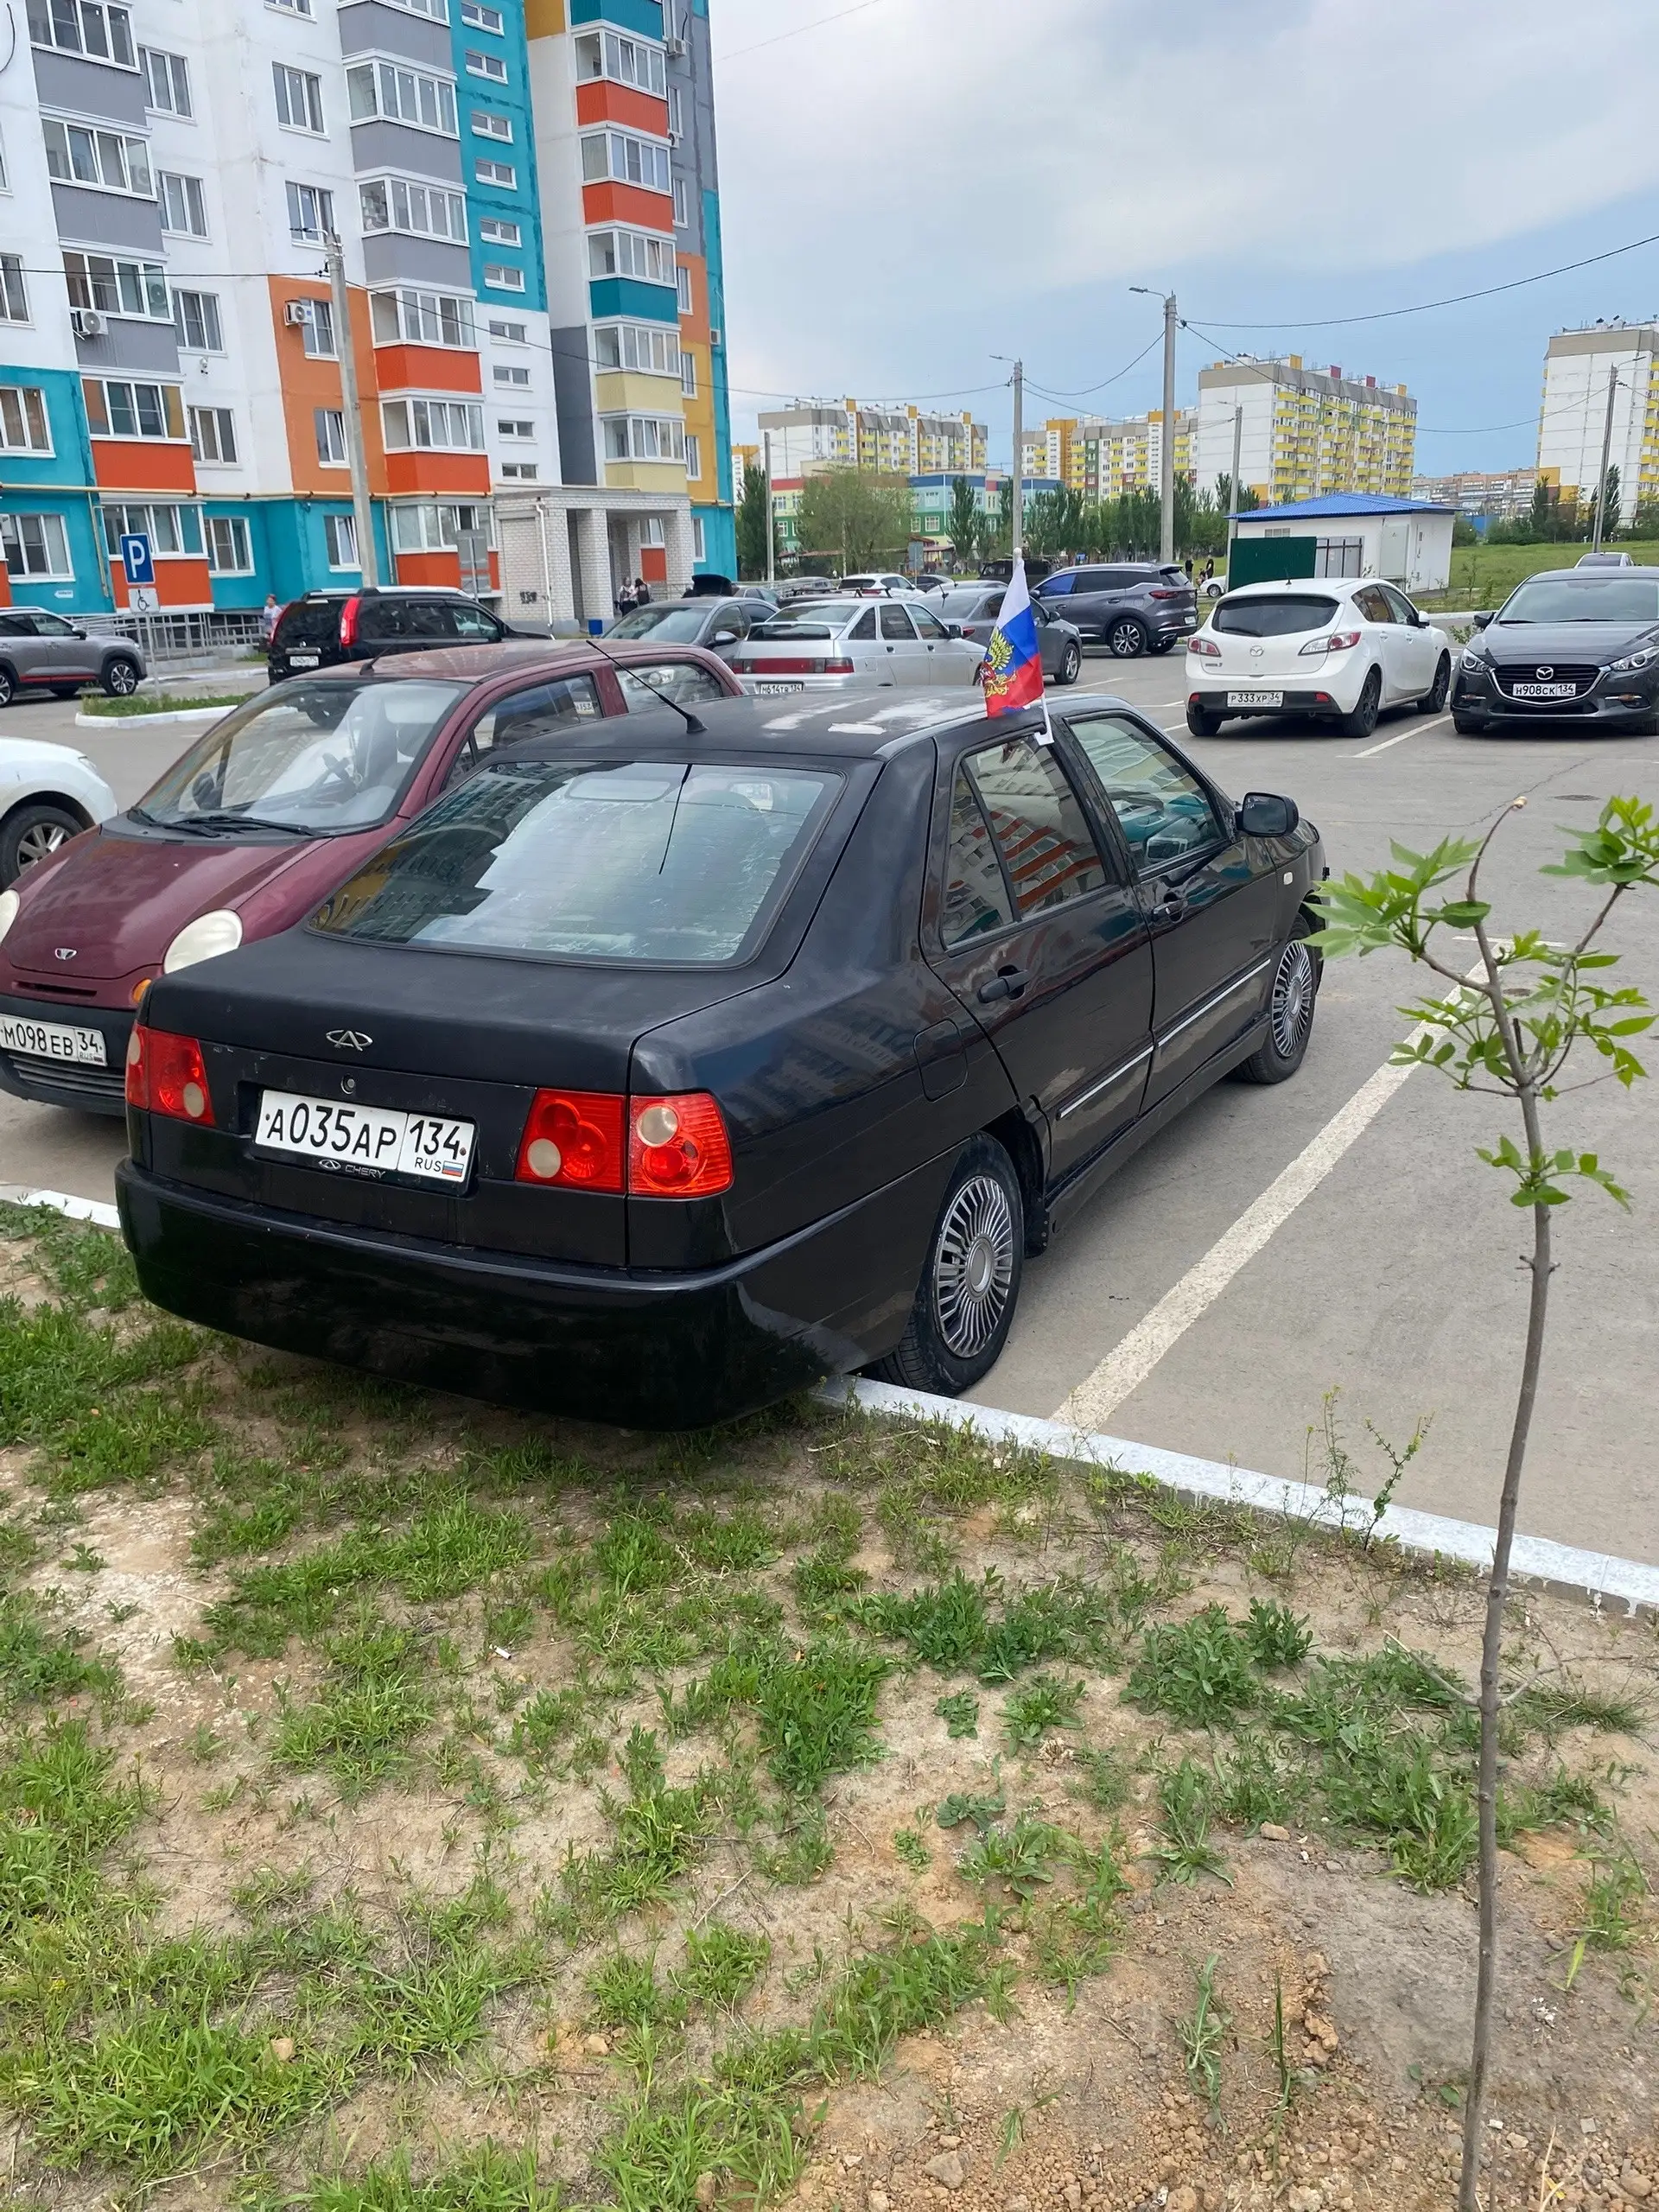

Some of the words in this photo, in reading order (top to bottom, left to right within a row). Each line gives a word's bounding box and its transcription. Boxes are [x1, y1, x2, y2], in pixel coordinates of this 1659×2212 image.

[128, 540, 145, 578] P
[1231, 693, 1267, 702] Р333ХР
[1516, 685, 1555, 695] Н908СК
[3, 1023, 73, 1056] М098ЕВ
[77, 1031, 99, 1052] 34
[266, 1103, 397, 1159] А035АР
[410, 1119, 461, 1160] 134
[346, 1164, 386, 1179] CHERY
[415, 1157, 442, 1173] RUS
